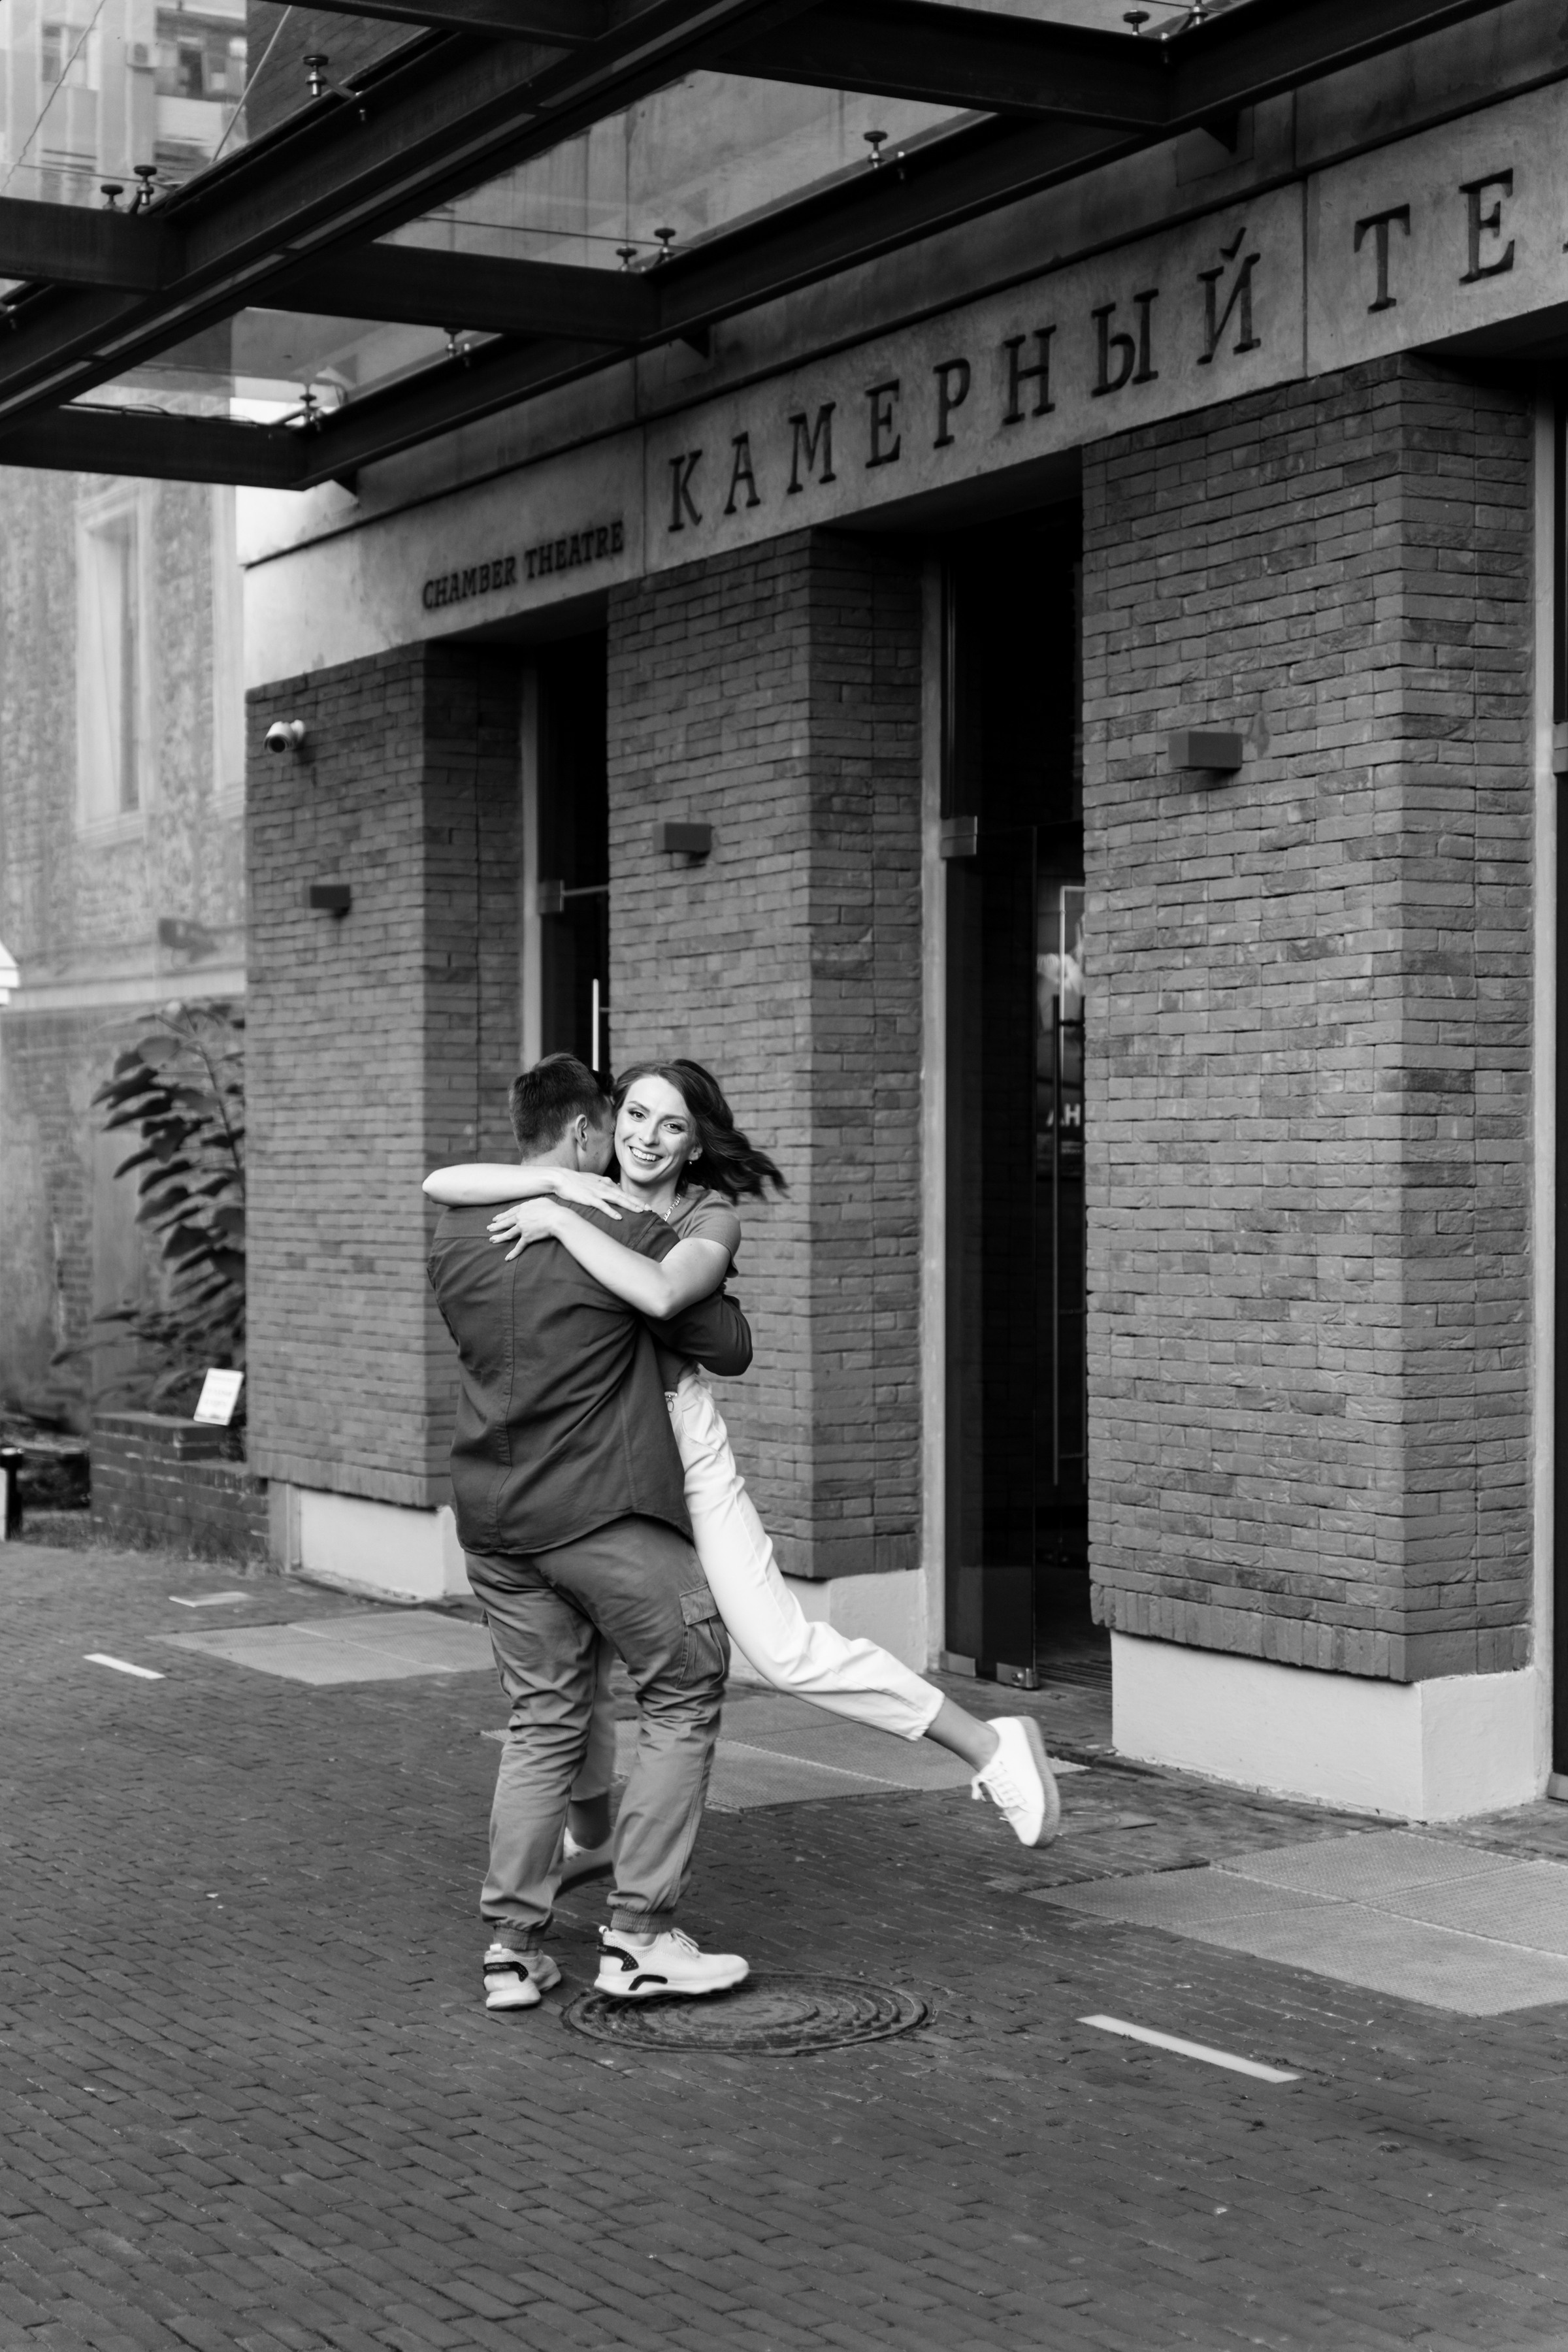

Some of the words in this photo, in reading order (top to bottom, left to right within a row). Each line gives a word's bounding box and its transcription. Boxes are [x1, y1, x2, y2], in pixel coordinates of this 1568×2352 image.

[666, 226, 1262, 533] КАМЕРНЫЙ
[1353, 167, 1568, 314] ТЕ
[422, 555, 518, 610] CHAMBER
[524, 520, 624, 579] THEATRE
